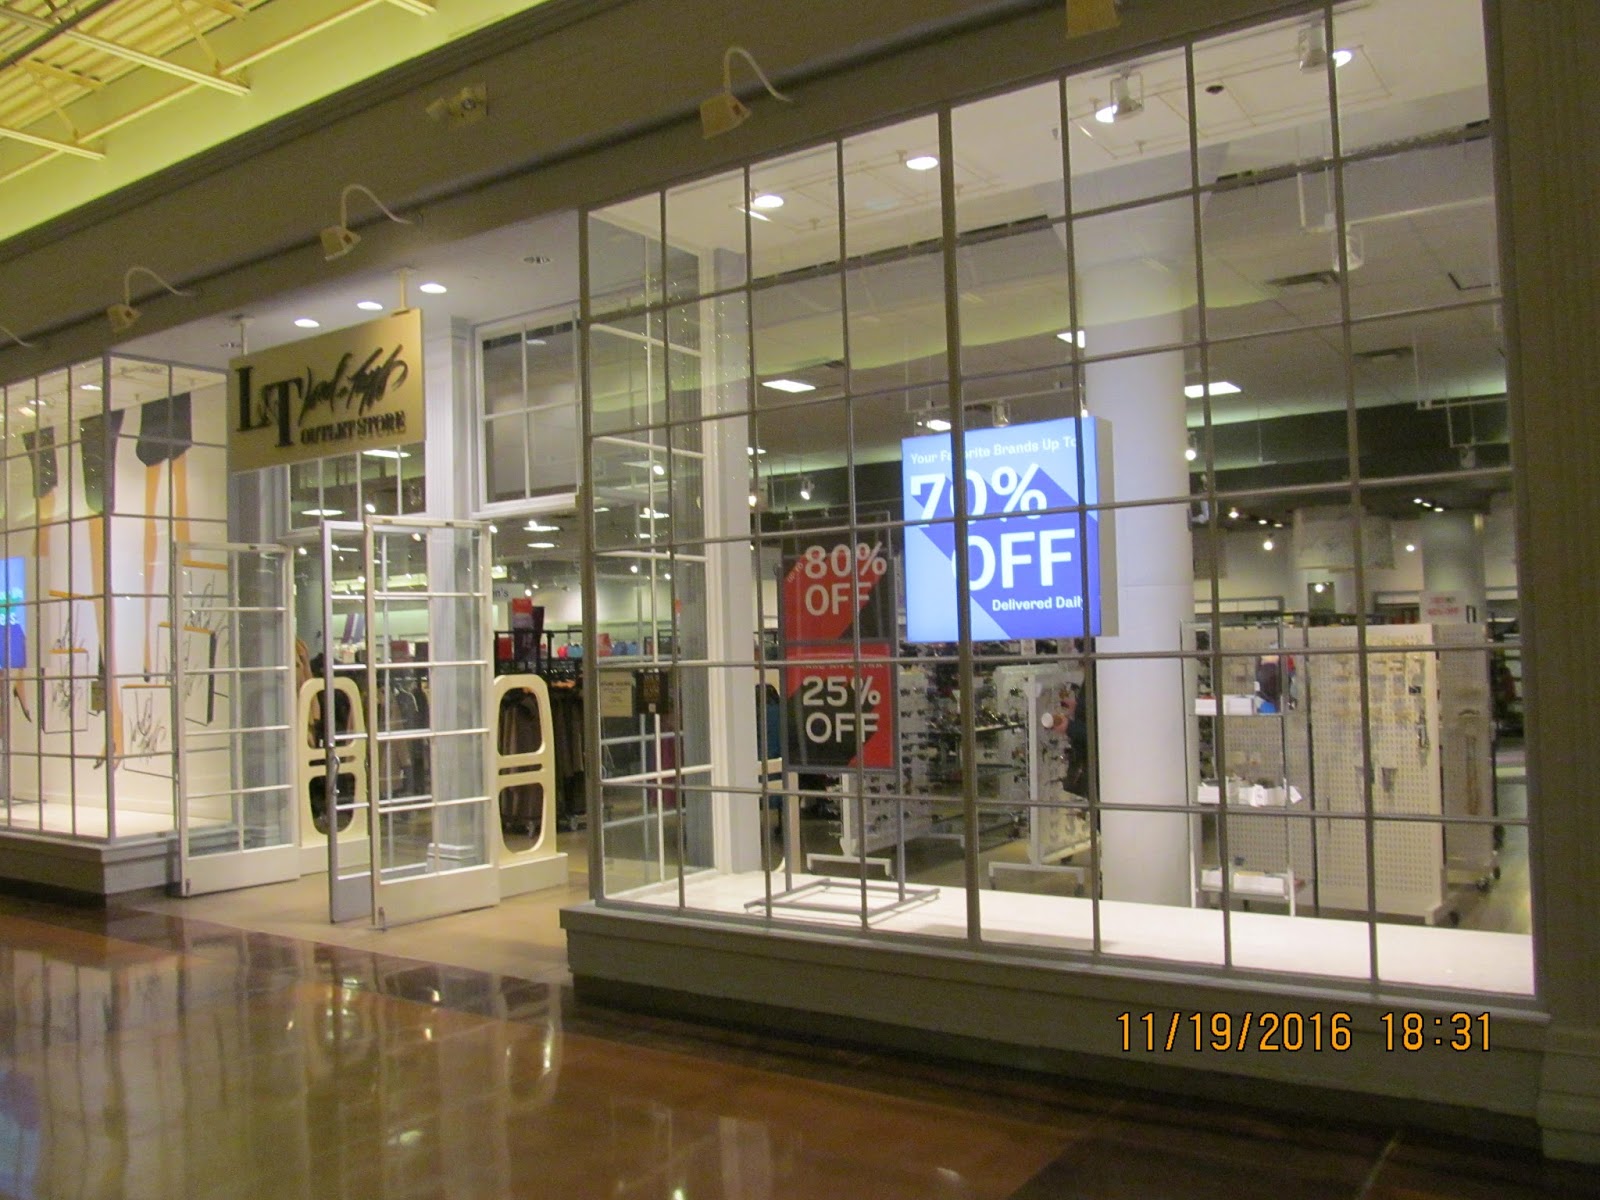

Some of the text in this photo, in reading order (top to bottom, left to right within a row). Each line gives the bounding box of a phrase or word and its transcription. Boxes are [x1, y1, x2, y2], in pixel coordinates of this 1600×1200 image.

[357, 410, 406, 438] STORE
[911, 452, 938, 465] Your
[940, 446, 991, 463] Faorite
[993, 440, 1039, 456] Brands
[1042, 438, 1060, 453] Up
[804, 541, 888, 580] 80%
[951, 528, 1076, 592] OFF
[804, 582, 873, 616] OFF
[992, 596, 1053, 612] Delivered
[802, 675, 882, 707] 25%
[805, 711, 880, 744] OFF
